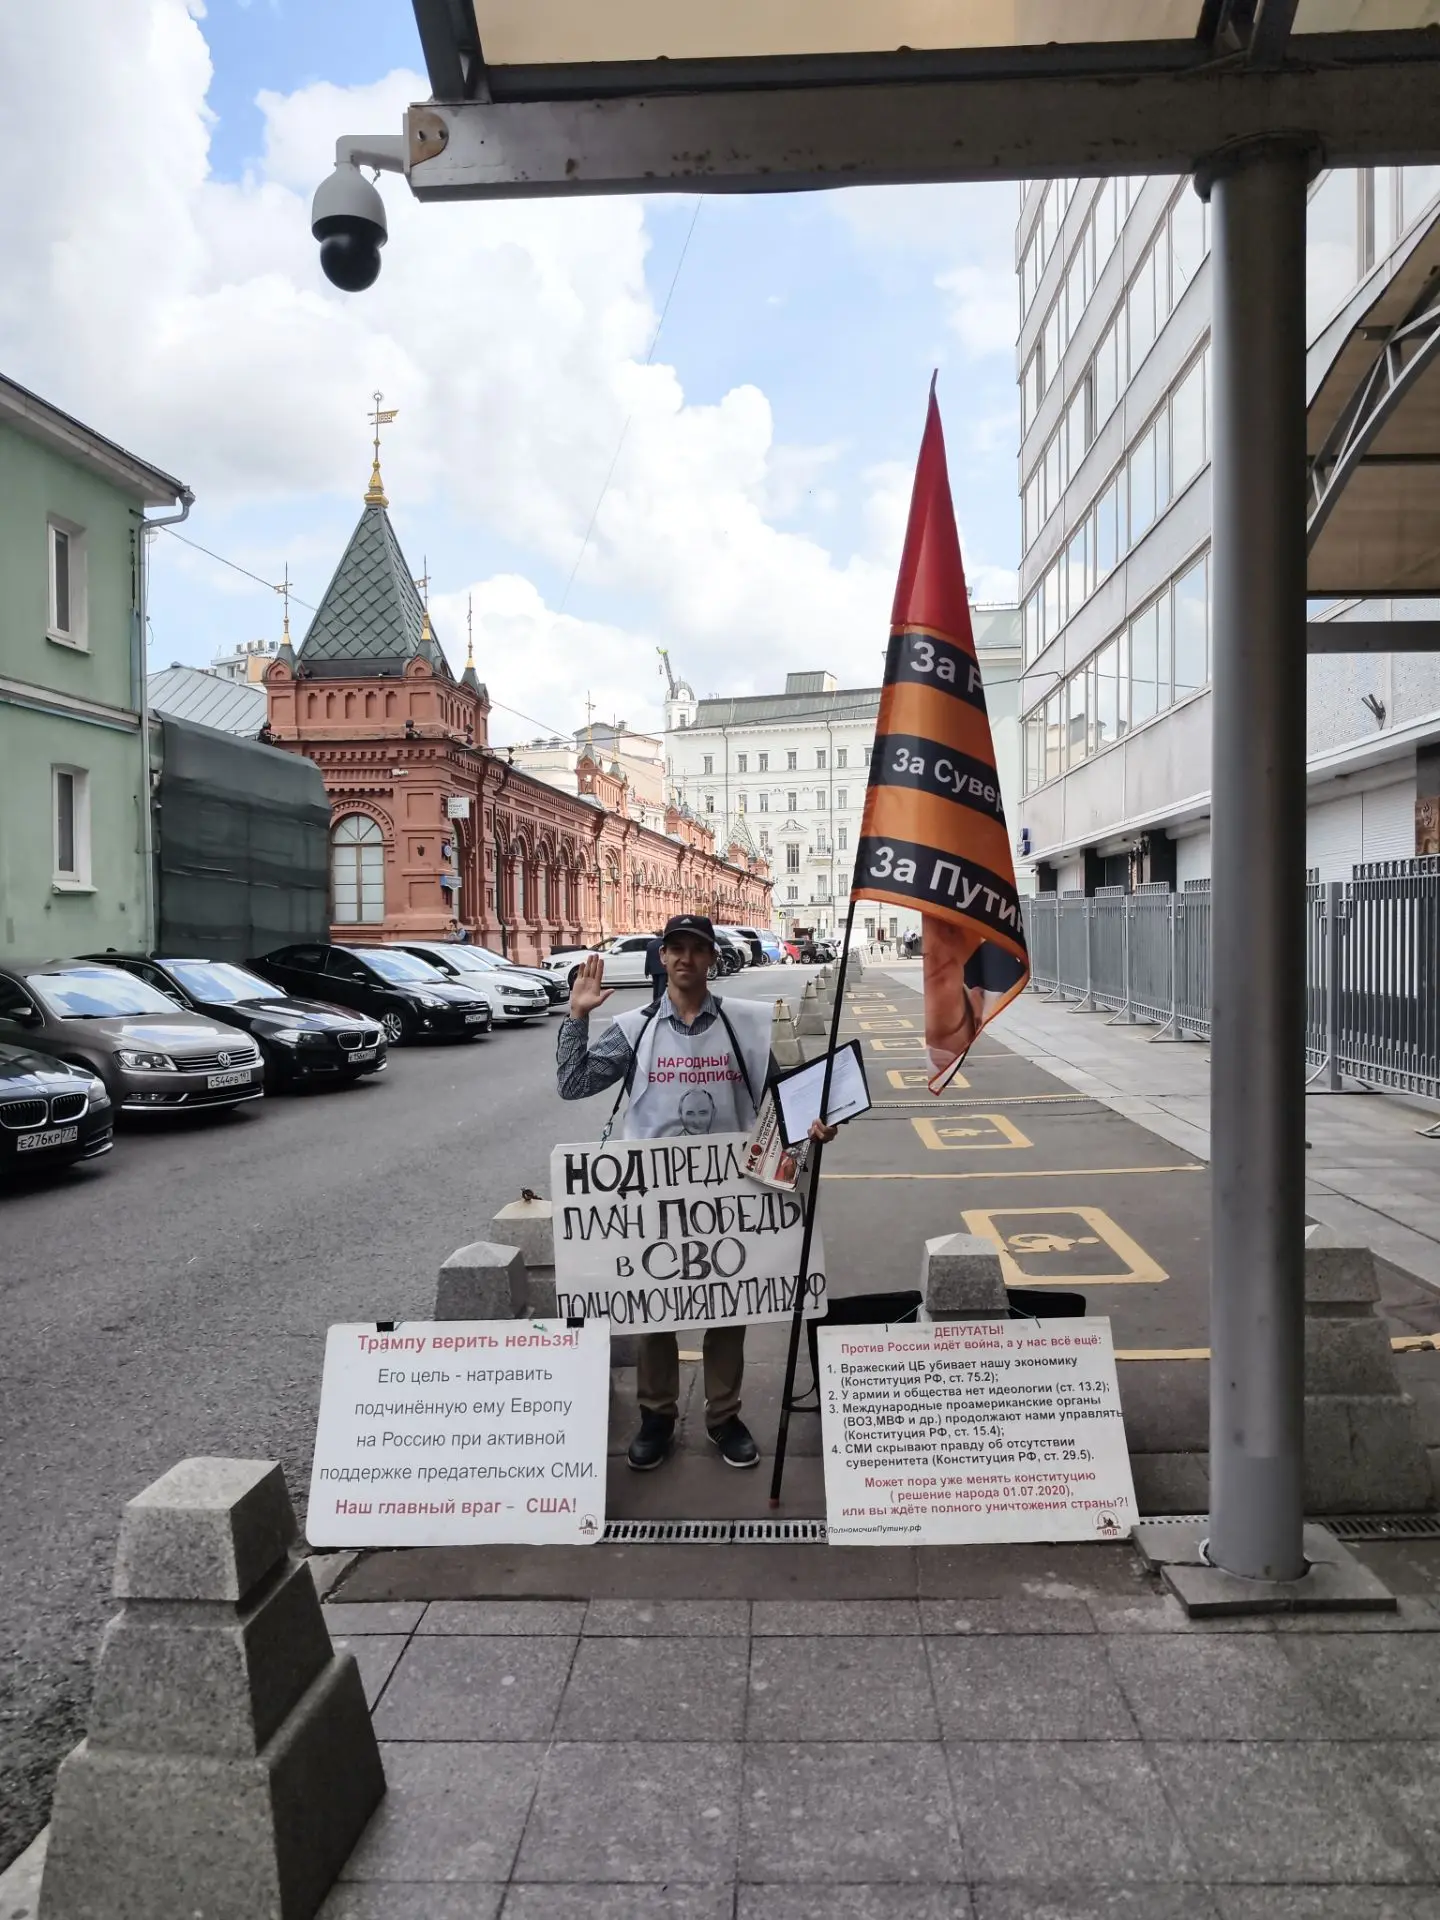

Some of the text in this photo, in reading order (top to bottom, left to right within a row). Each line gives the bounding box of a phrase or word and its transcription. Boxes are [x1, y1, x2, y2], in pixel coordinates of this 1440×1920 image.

[910, 640, 955, 683] За
[892, 747, 925, 775] За
[869, 846, 917, 884] За
[679, 1070, 742, 1085] ПОДПИС
[564, 1150, 649, 1199] НОД
[650, 1141, 747, 1188] ПРЕДЛ
[563, 1193, 809, 1240] ПЛАН ПОБЕДЫ
[642, 1237, 746, 1280] СВО
[934, 1325, 1004, 1338] ДЕПУТАТЫ!
[358, 1331, 580, 1354] Трампу верить нельзя!
[841, 1334, 1102, 1355] Против России идёт война, а у нас всё ещё:
[827, 1356, 1078, 1374] 1. Вражеский ЦБ убивает нашу экономику
[378, 1369, 406, 1384] Его
[412, 1370, 450, 1385] цель
[467, 1369, 552, 1383] натравить
[841, 1371, 999, 1388] (Конституция РФ, ст. 75.2);
[828, 1380, 1110, 1402] 2. У армии и общества нет идеологии (ст. 13.2);
[355, 1398, 572, 1417] подчинённую ему Европу
[829, 1396, 1101, 1414] 3. Международные проамериканские органы
[908, 1416, 916, 1425] и
[919, 1414, 942, 1427] др.)
[945, 1413, 1022, 1425] продолжают
[1025, 1411, 1056, 1421] нами
[1060, 1409, 1124, 1421] управлять
[357, 1429, 565, 1449] на Россию при активной
[844, 1425, 1005, 1443] (Конституция РФ, ст. 15.4);
[831, 1438, 1076, 1455] 4. СМИ скрывают правду об отсутствии
[846, 1449, 1095, 1469] суверенитета (Конституция РФ, ст. 29.5).
[320, 1462, 598, 1483] поддержке предательских СМИ.
[864, 1471, 1096, 1488] Может пора уже менять конституцию
[897, 1490, 952, 1502] решение
[955, 1488, 1000, 1499] народа
[336, 1500, 372, 1514] Наш
[378, 1499, 455, 1514] главный
[461, 1501, 501, 1516] враг
[526, 1498, 577, 1513] США!
[842, 1497, 1129, 1516] или вы ждёте полного уничтожения страны?!
